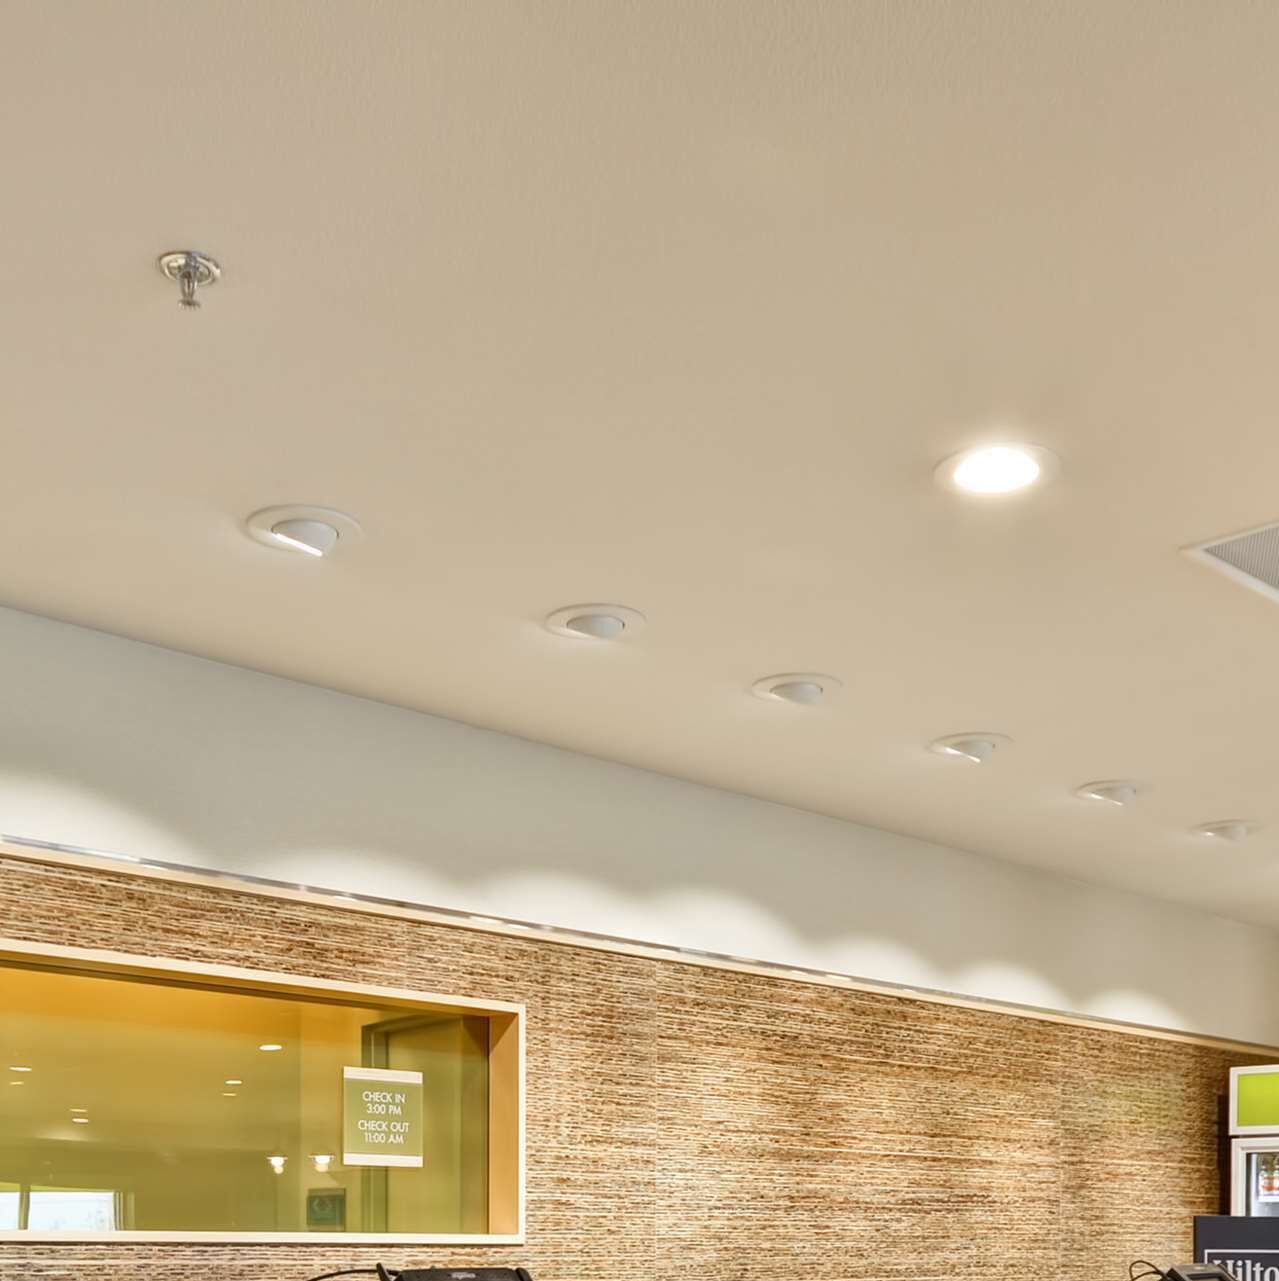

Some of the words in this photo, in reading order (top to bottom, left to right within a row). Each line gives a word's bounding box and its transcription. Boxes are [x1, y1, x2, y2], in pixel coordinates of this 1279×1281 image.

[362, 1091, 393, 1103] CHECK
[394, 1093, 405, 1103] IN
[366, 1103, 386, 1114] 3:00
[388, 1105, 402, 1115] PM
[358, 1120, 389, 1132] CHECK
[390, 1122, 410, 1133] OUT
[365, 1132, 386, 1144] 11:00
[388, 1134, 405, 1144] AM
